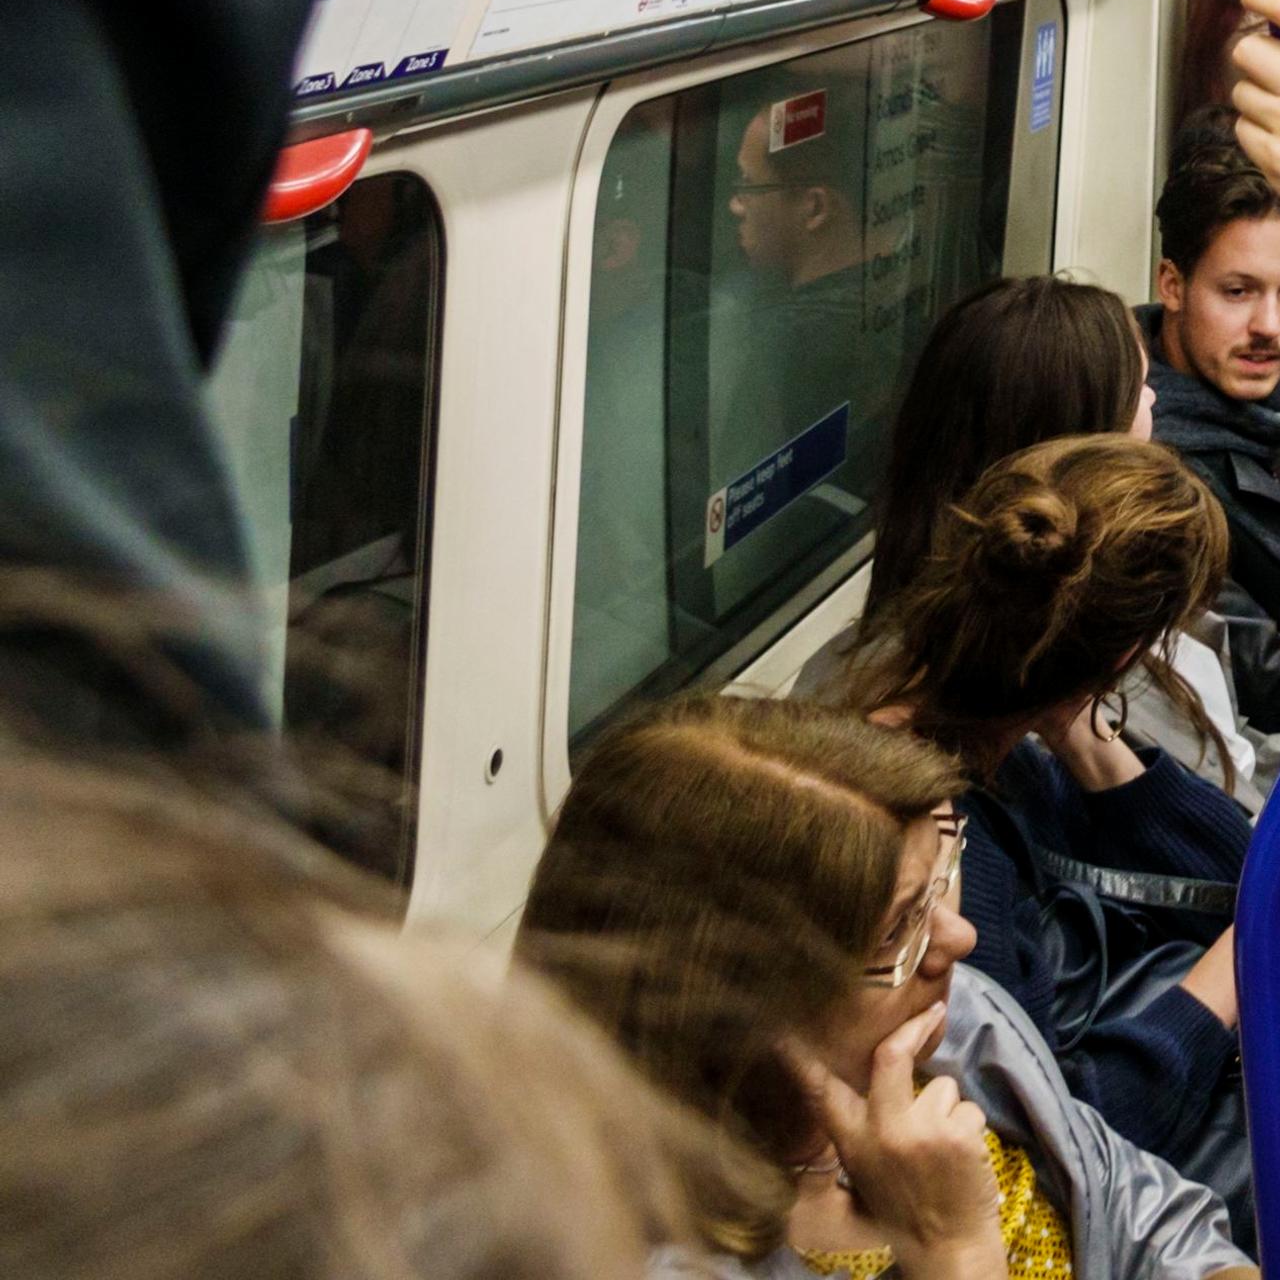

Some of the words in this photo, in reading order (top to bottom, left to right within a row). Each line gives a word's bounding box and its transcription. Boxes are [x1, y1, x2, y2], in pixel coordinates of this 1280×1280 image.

[405, 57, 429, 72] Zone
[430, 52, 438, 67] 5
[297, 77, 324, 95] Zone
[324, 74, 334, 89] 3
[348, 69, 373, 84] Zone
[373, 65, 383, 78] 4
